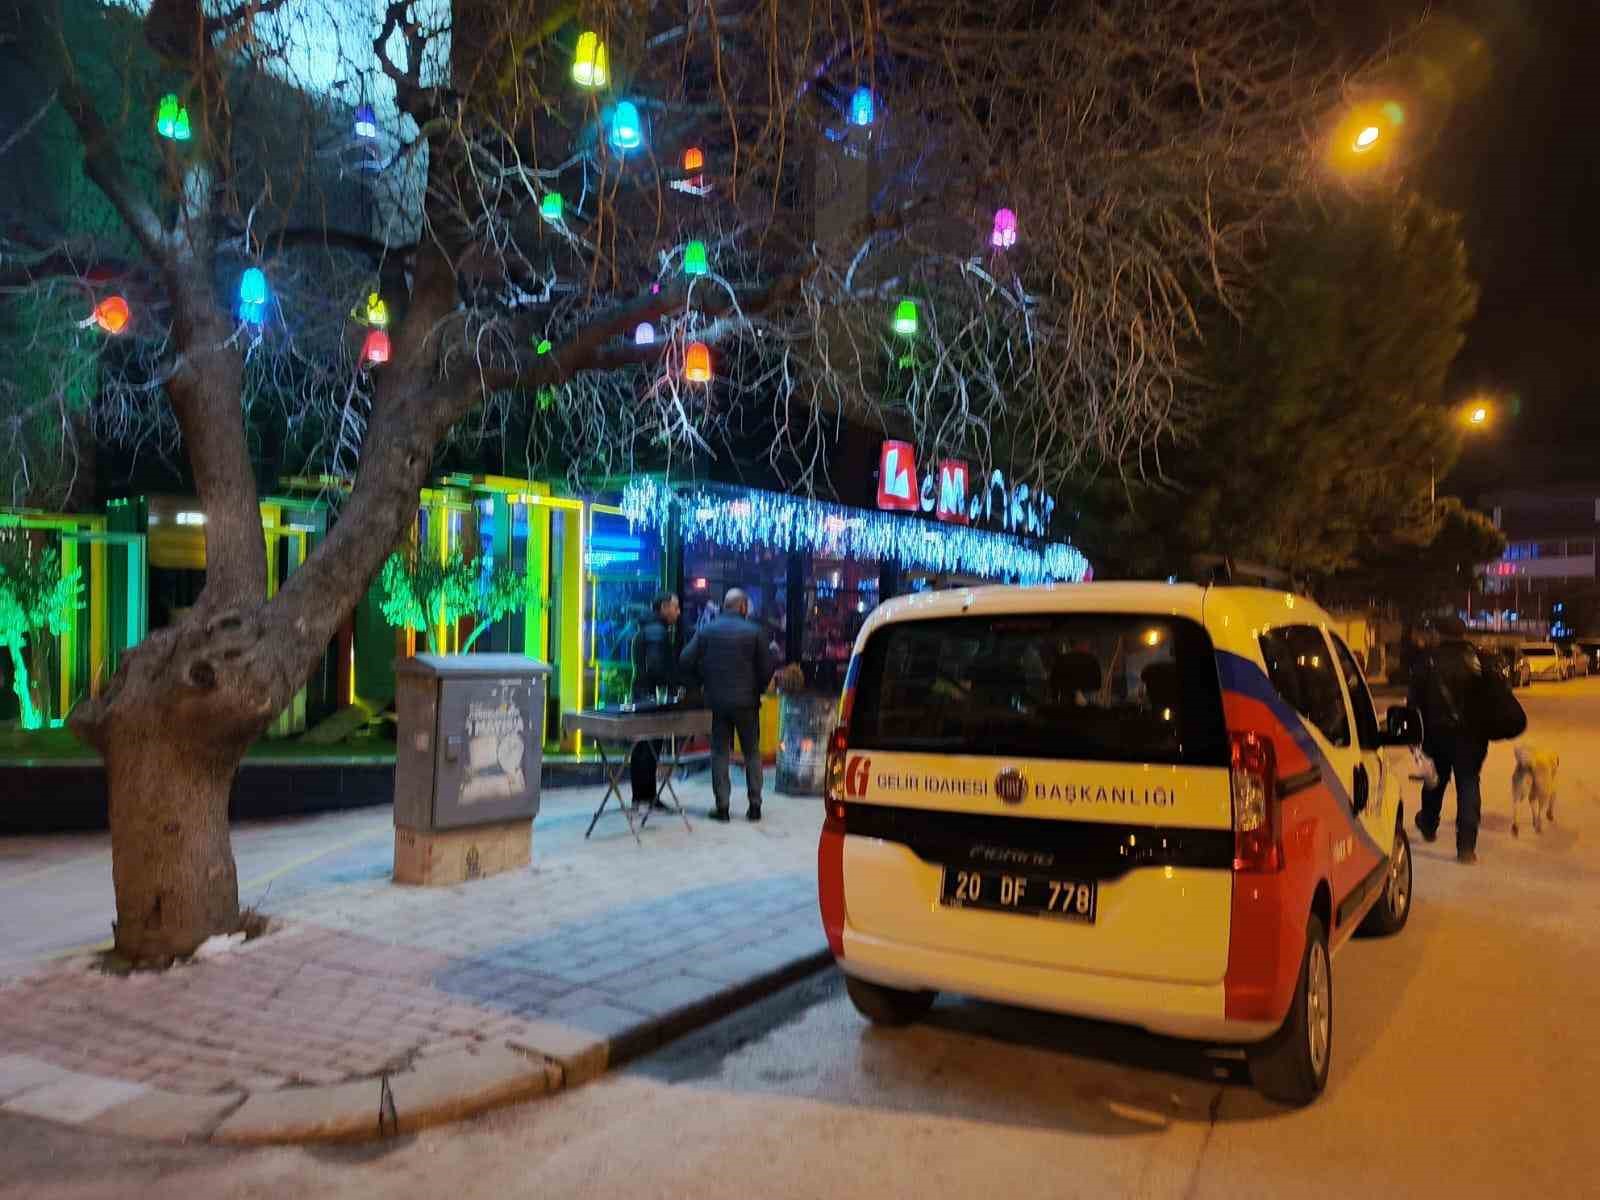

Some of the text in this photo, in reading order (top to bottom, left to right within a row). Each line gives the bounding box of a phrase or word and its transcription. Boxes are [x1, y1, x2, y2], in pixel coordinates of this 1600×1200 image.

[1034, 782, 1176, 808] BAŞKANLIĞI
[955, 870, 1091, 914] 20 DF 778
